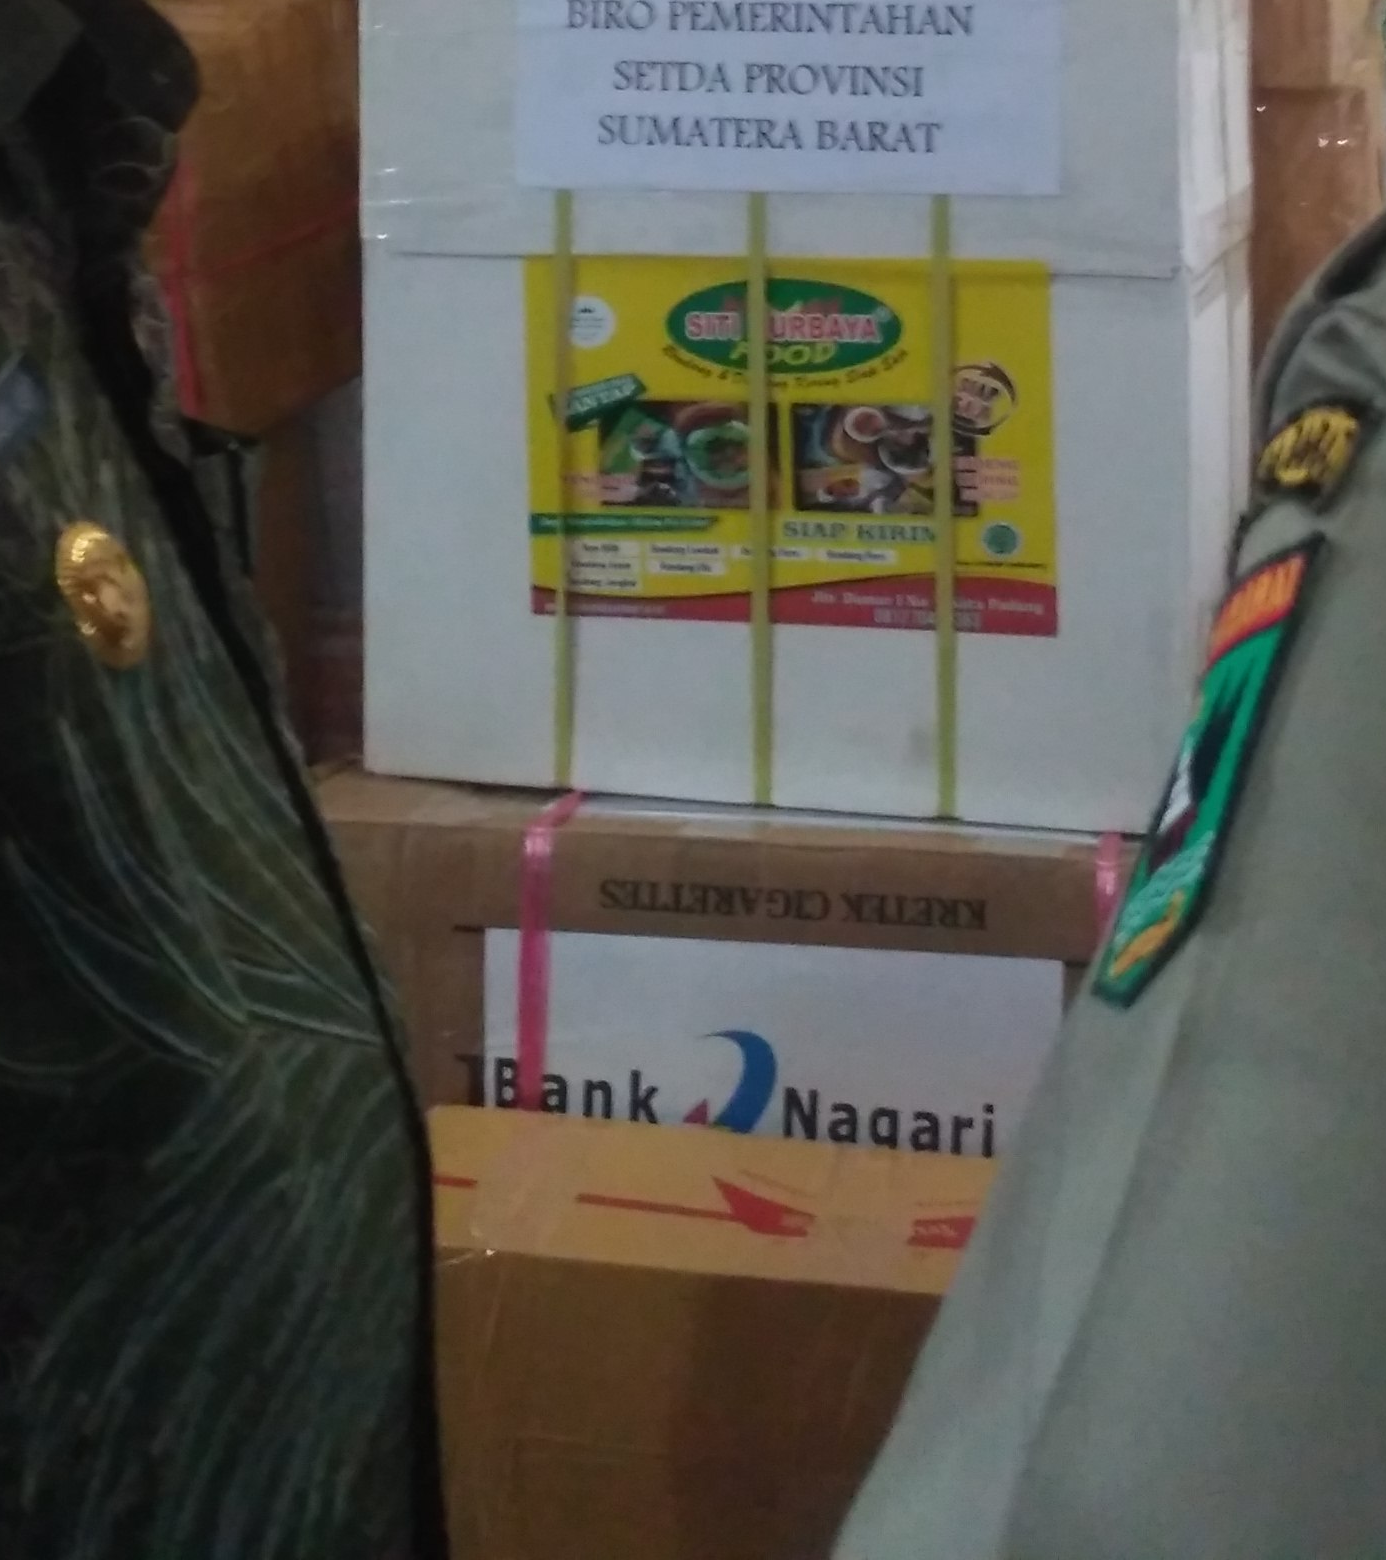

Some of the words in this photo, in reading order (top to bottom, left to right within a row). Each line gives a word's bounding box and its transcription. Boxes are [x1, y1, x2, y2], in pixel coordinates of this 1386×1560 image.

[668, 0, 977, 37] PEMERINTAHAN
[613, 60, 732, 95] SETDA
[744, 63, 924, 98] PROVINSI
[596, 114, 803, 150] SUMATERA
[816, 120, 944, 154] BARAT
[685, 312, 741, 341] SITI
[763, 313, 883, 343] URBAYA
[599, 878, 830, 923] CIGARETTES
[843, 890, 987, 931] KRETEK
[494, 1057, 659, 1126] Bank
[783, 1087, 996, 1159] Nagari
